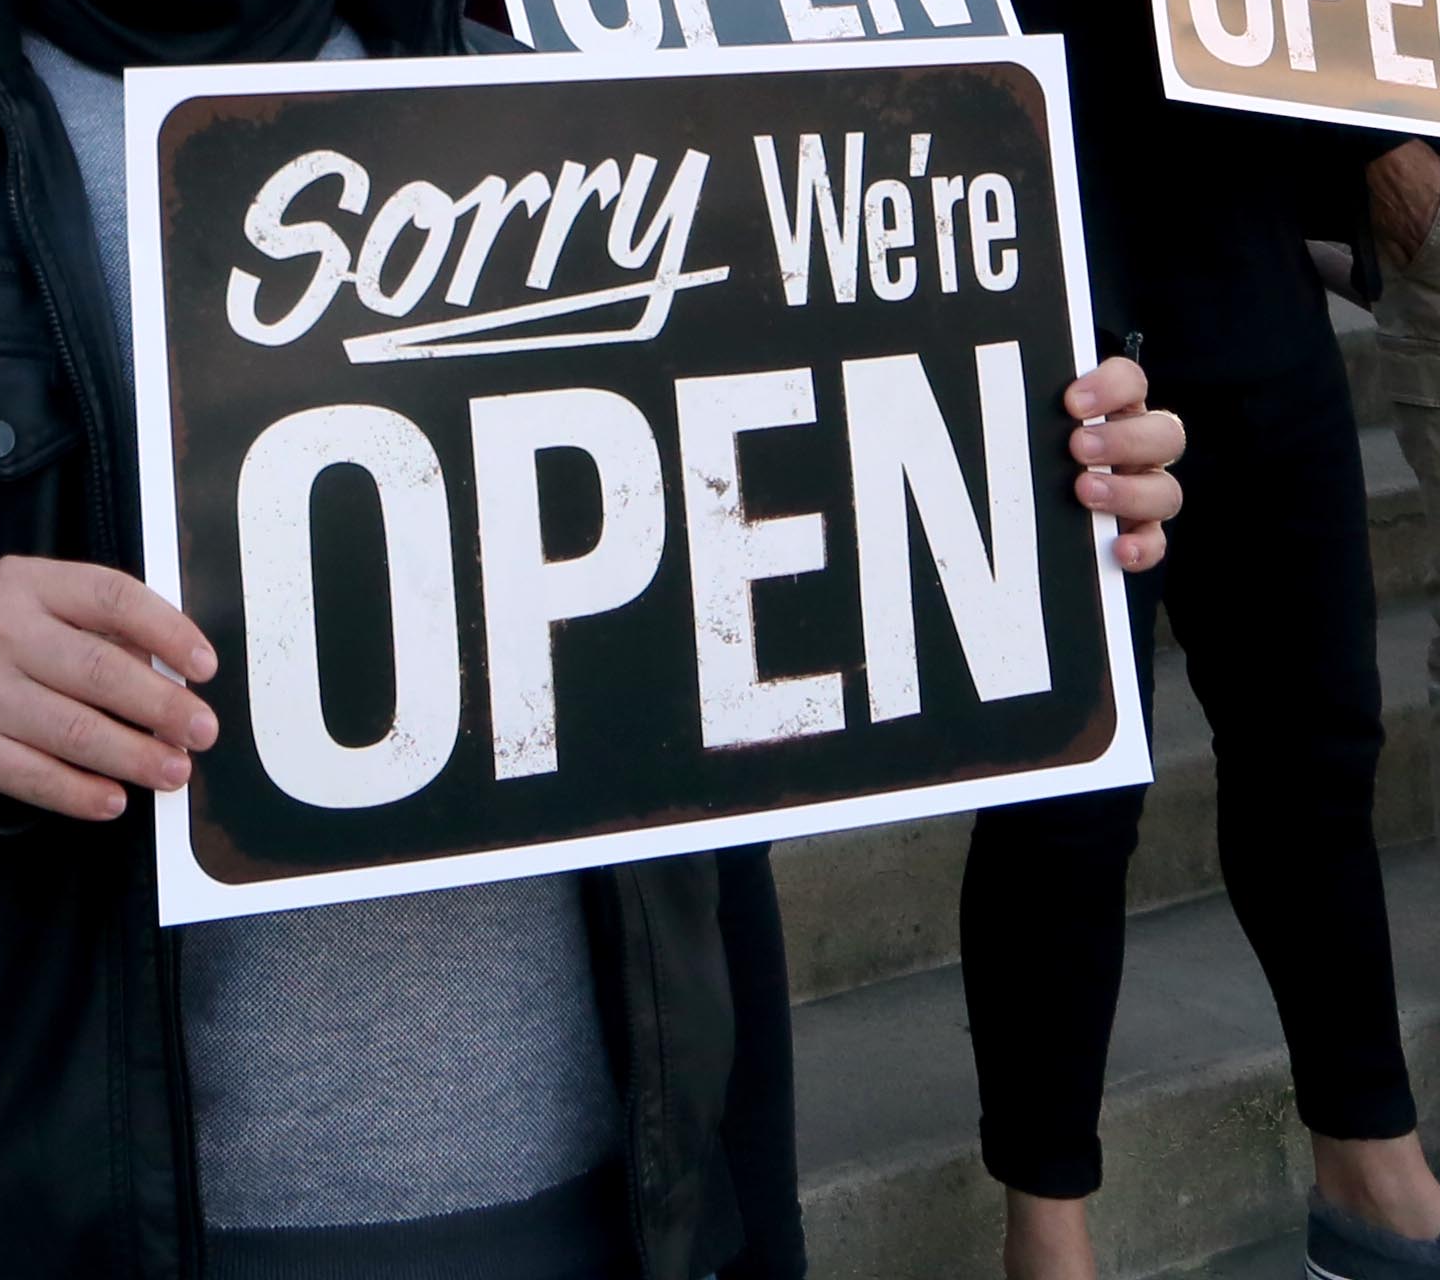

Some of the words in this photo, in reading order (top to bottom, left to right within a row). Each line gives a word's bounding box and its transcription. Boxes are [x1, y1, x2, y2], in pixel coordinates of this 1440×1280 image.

[224, 147, 730, 365] Sorry
[753, 131, 1020, 308] We're
[235, 340, 1053, 810] OPEN
